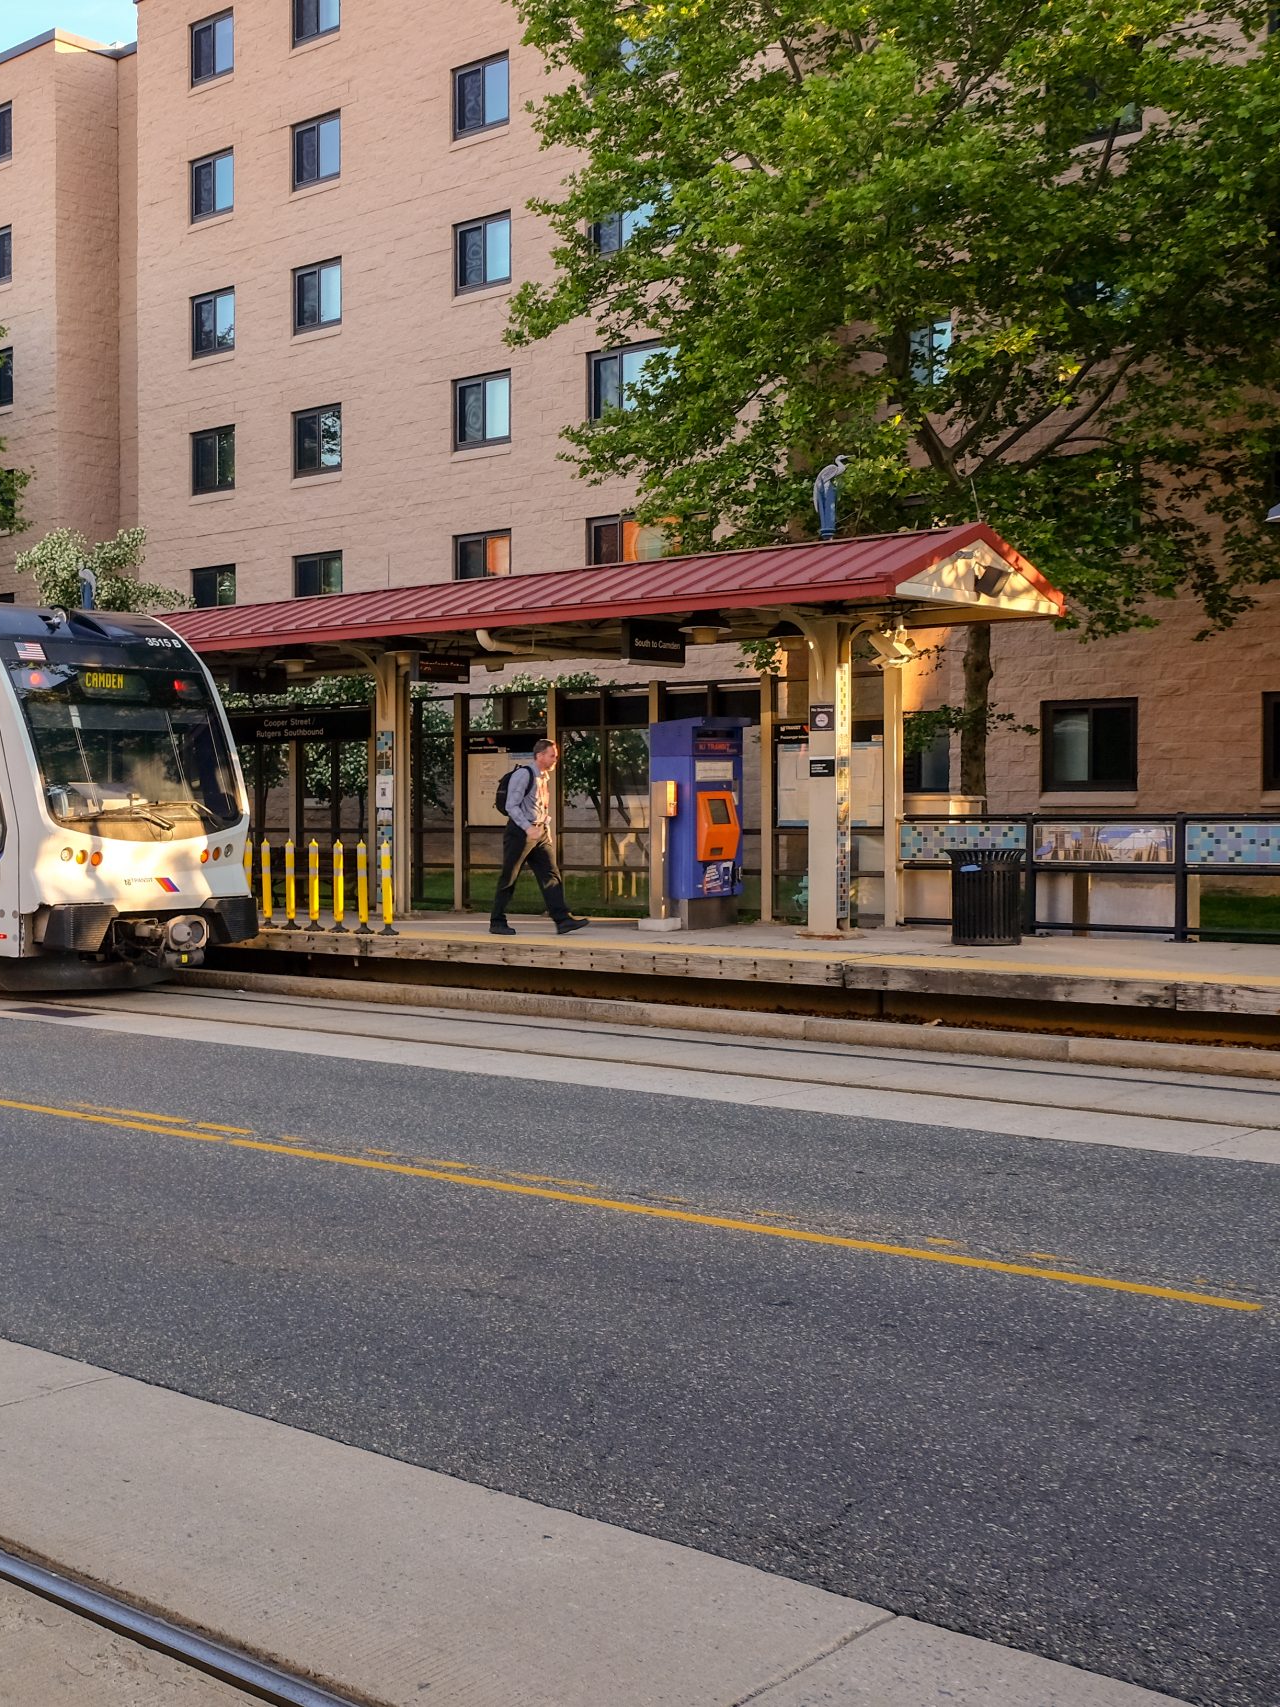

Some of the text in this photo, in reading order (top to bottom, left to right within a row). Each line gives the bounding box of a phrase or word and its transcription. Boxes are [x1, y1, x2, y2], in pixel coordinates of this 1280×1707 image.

[145, 637, 182, 649] 3515 B
[634, 638, 681, 650] South to Camden
[85, 672, 124, 689] CAMDEN
[263, 719, 288, 728] Cooper
[256, 728, 324, 739] Rutgers Southbound
